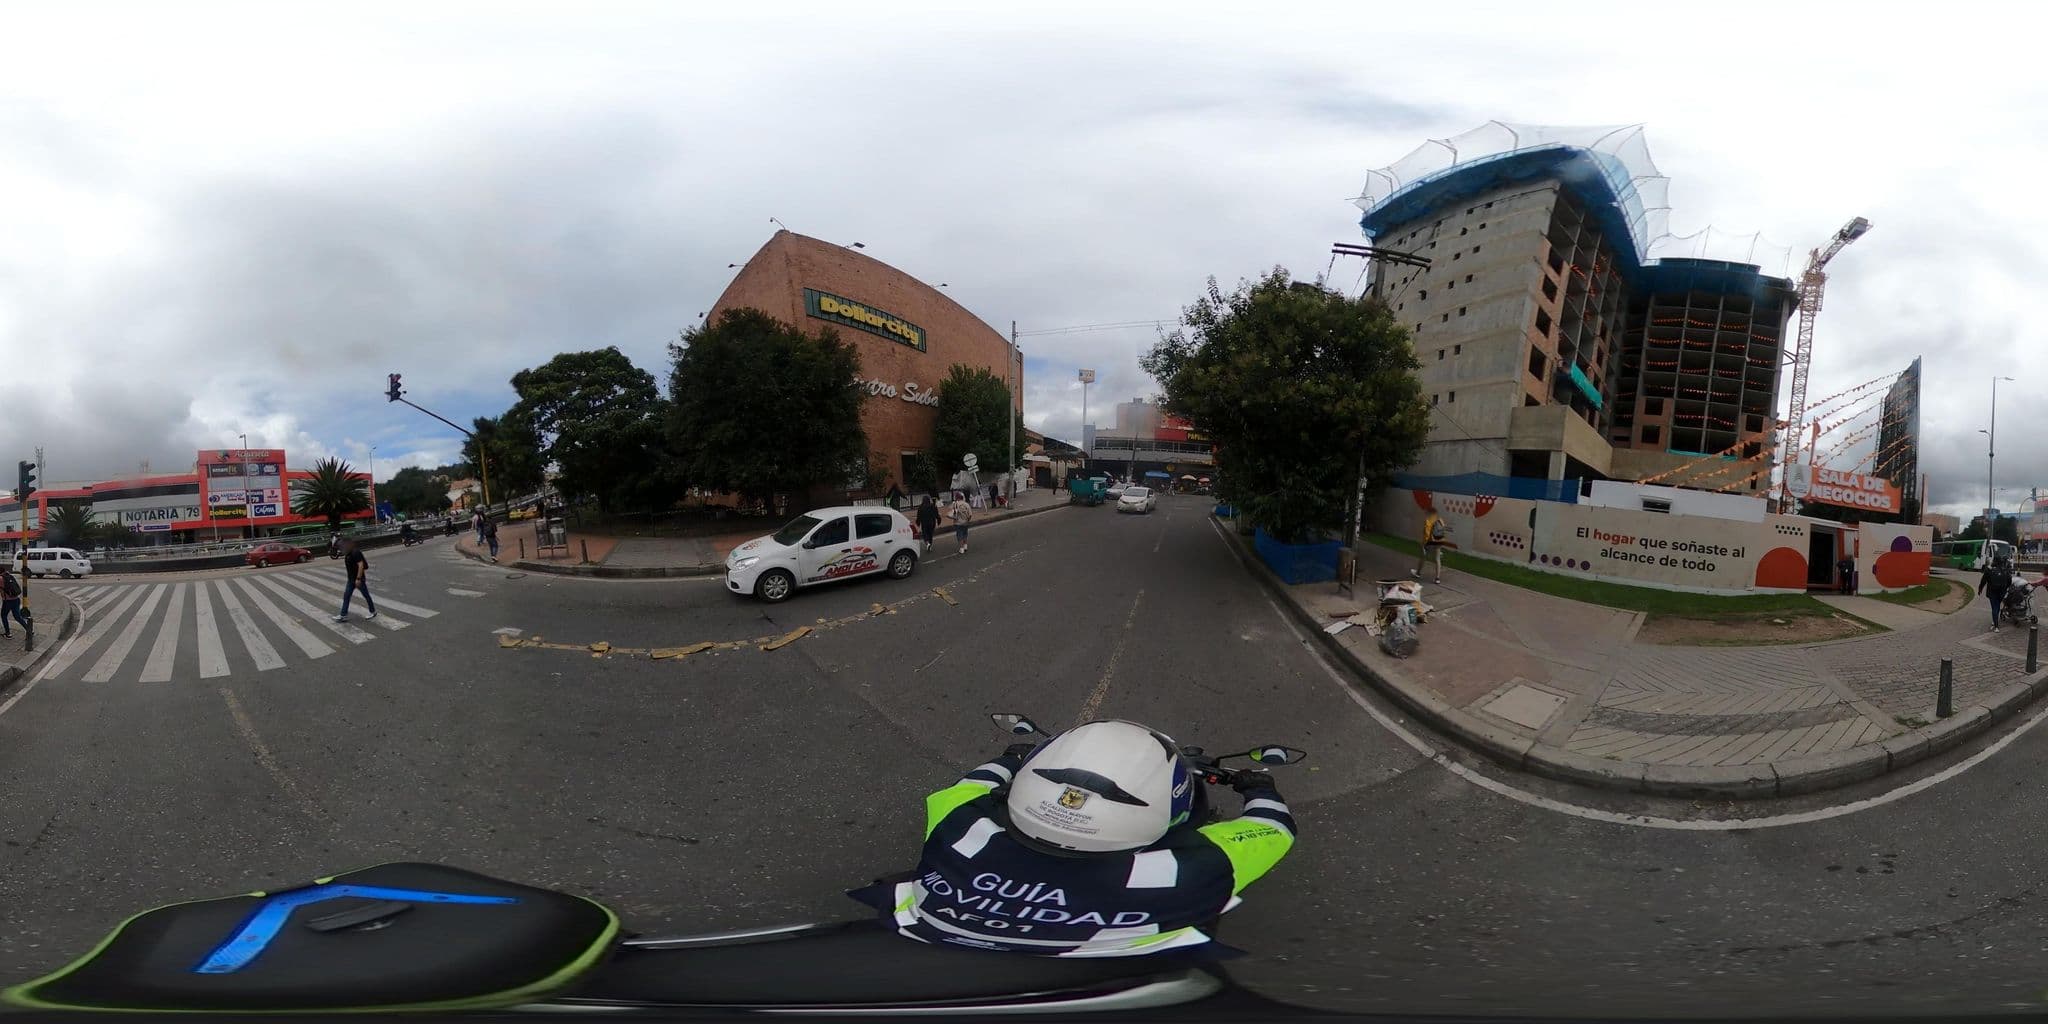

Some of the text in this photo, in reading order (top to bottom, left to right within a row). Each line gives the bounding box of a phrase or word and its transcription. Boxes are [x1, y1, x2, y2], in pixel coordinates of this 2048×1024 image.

[819, 296, 920, 346] Dollarcity
[901, 382, 939, 408] Suba
[1818, 468, 1885, 492] SALA DE
[1811, 483, 1892, 510] NEGOCIOS
[126, 507, 200, 522] NOTARIA 79
[1576, 526, 1745, 558] El hogar que soñaste al
[853, 559, 876, 571] CAR
[1600, 547, 1716, 572] alcance de todo
[924, 871, 1150, 926] MOVILIDAD
[972, 872, 1068, 906] GUÍA
